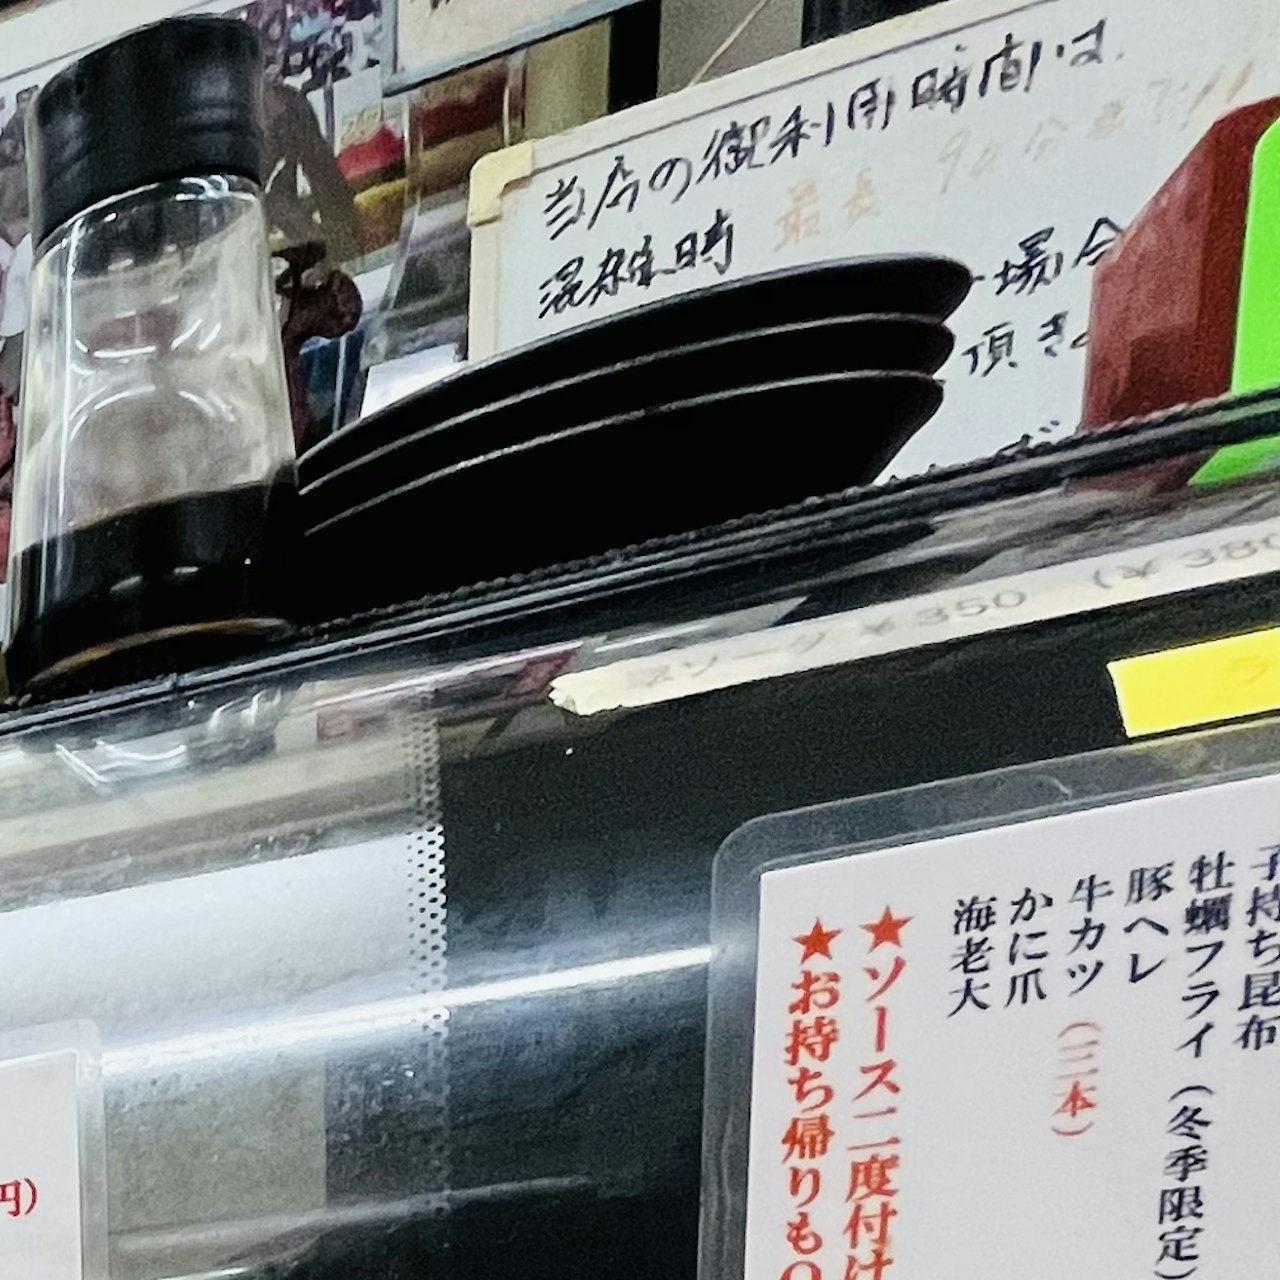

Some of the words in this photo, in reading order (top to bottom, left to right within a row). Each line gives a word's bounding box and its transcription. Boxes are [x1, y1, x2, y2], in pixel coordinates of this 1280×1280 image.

[946, 895, 999, 1018] 海老大
[1003, 887, 1054, 1009] かに爪
[1067, 873, 1113, 999] 牛カツ
[1124, 861, 1175, 985] 豚ヘレ
